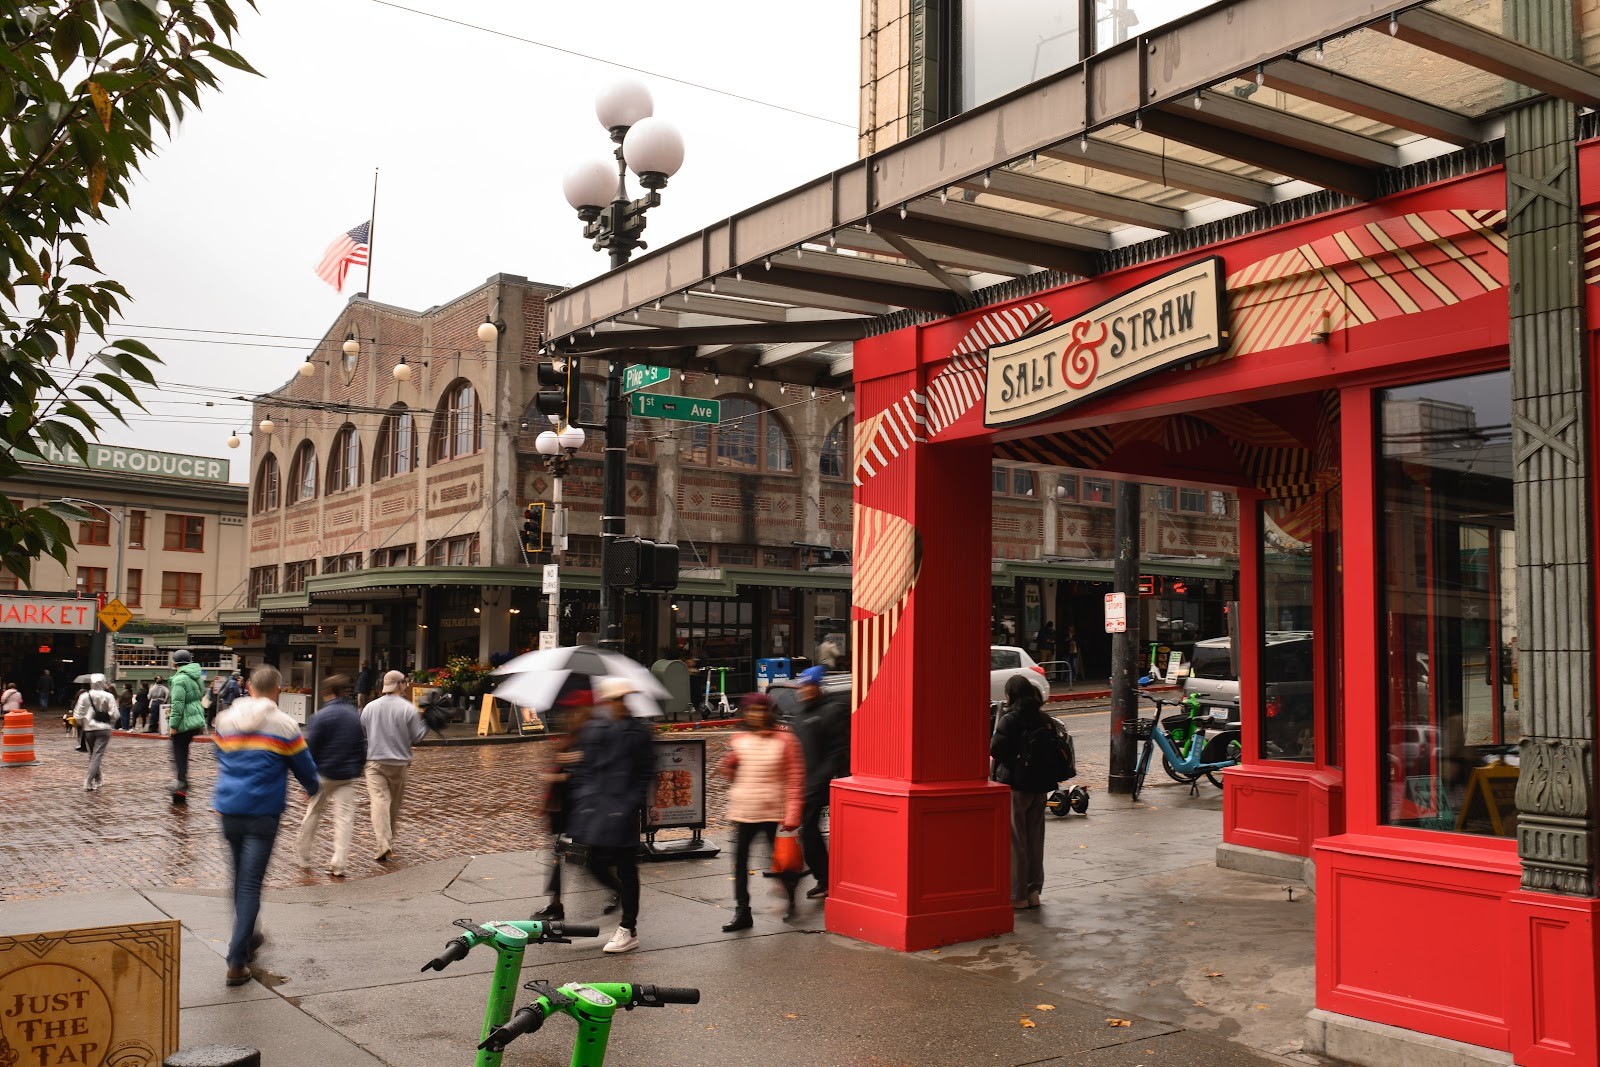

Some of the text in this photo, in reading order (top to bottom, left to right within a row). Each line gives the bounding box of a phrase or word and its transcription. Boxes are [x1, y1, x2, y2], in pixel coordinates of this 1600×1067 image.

[1001, 290, 1196, 403] SALT & STRAW
[626, 367, 658, 389] Pike St
[639, 395, 712, 418] 1st Ave
[97, 448, 222, 479] PRODUCER
[547, 569, 554, 577] NO
[5, 990, 90, 1017] JUST
[17, 1017, 89, 1042] THE
[32, 1042, 98, 1067] TAP
